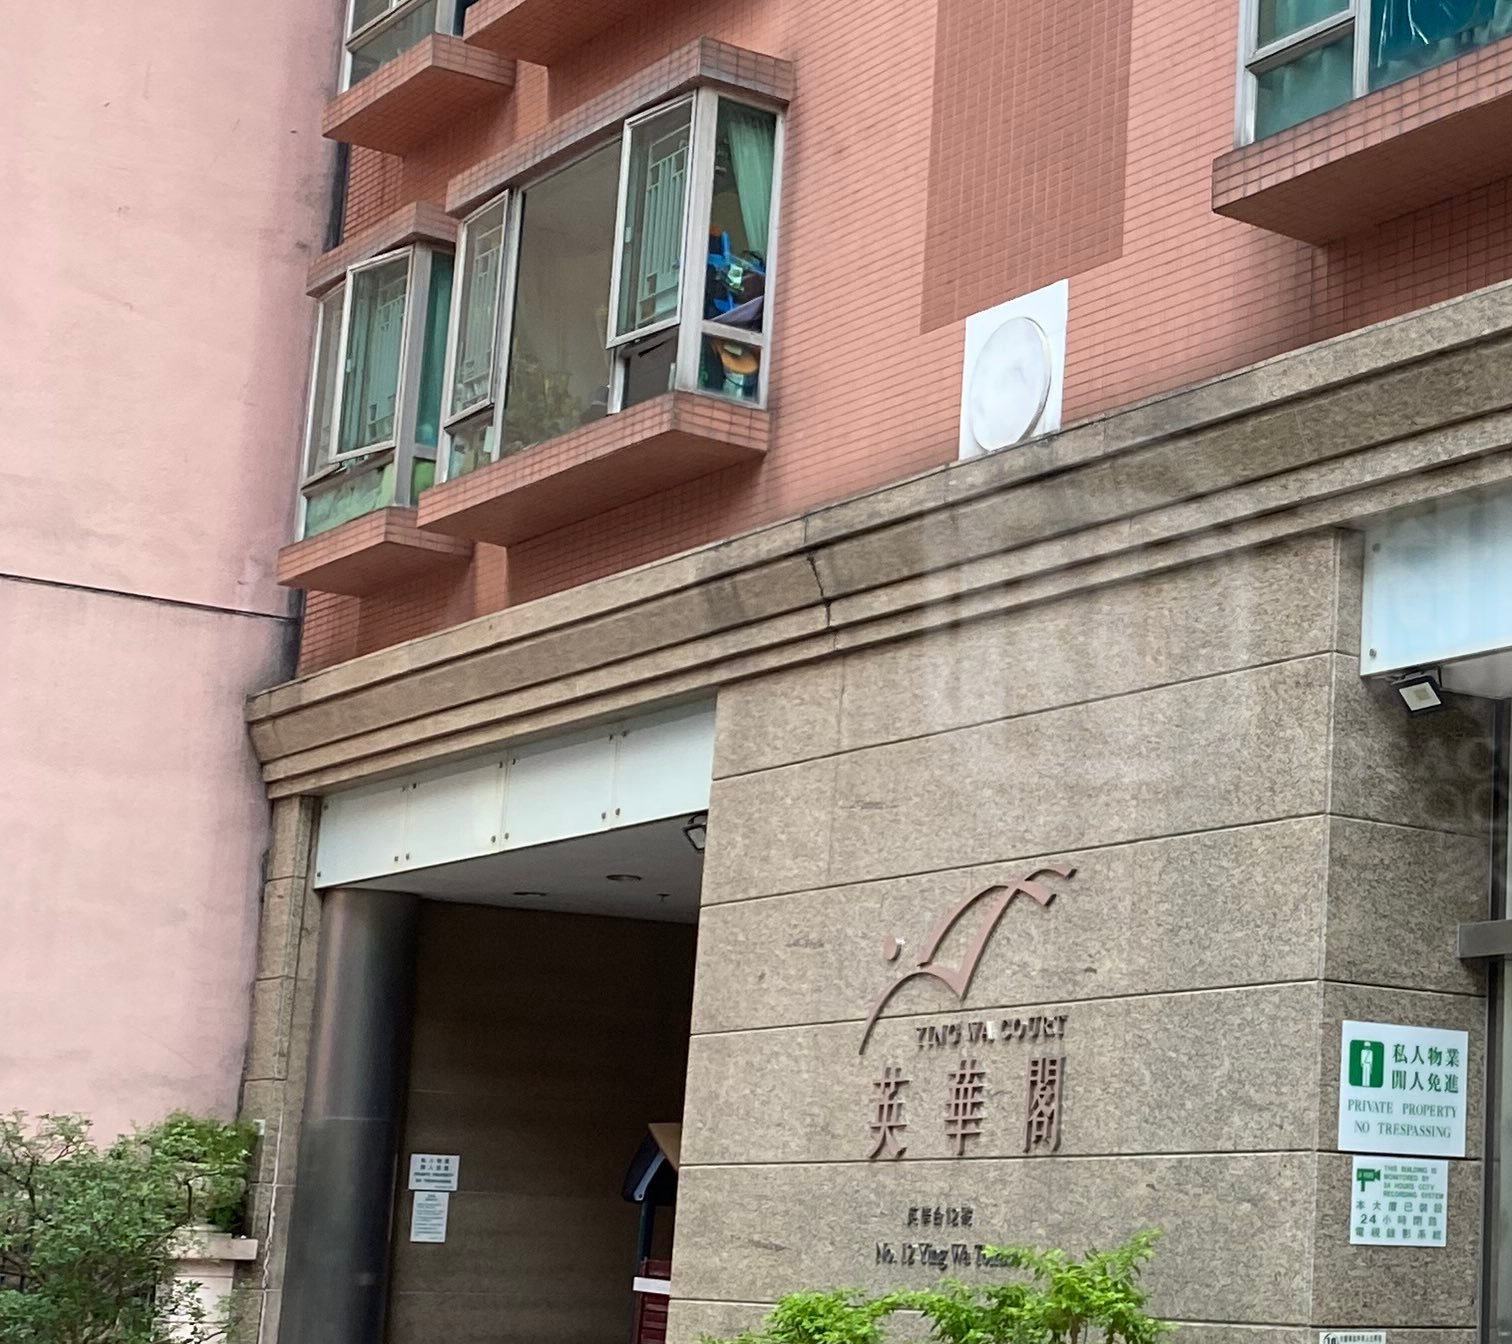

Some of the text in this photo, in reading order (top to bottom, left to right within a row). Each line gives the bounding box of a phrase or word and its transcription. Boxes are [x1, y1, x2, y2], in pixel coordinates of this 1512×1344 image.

[1392, 1043, 1460, 1067] 私人物業
[869, 1056, 1066, 1160] 英華閣
[1347, 1098, 1457, 1118] PRIVATE PROPERTY
[1354, 1119, 1452, 1138] NO TRESPASSING
